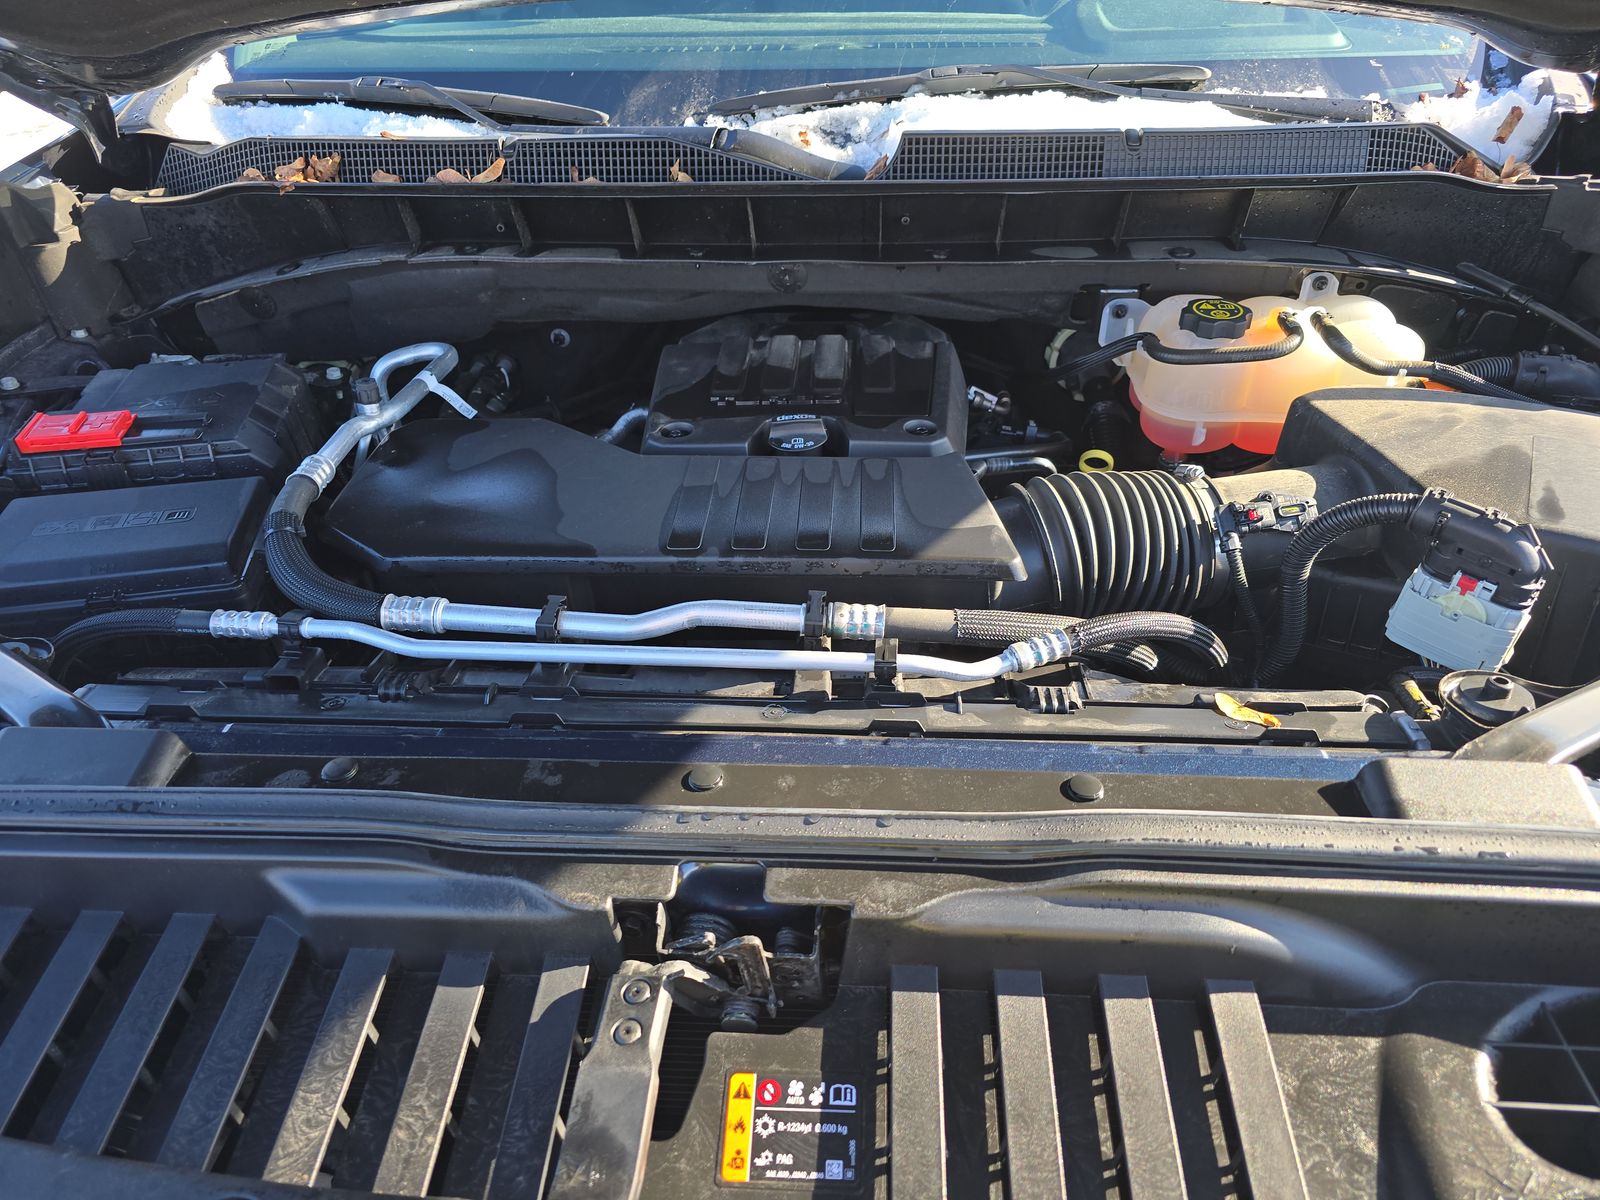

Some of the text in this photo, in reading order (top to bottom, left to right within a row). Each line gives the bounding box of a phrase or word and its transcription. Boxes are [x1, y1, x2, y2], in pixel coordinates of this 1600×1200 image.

[776, 414, 817, 422] dexos
[785, 1095, 806, 1105] AUTO
[837, 1123, 848, 1136] kg
[775, 1153, 794, 1165] PAG
